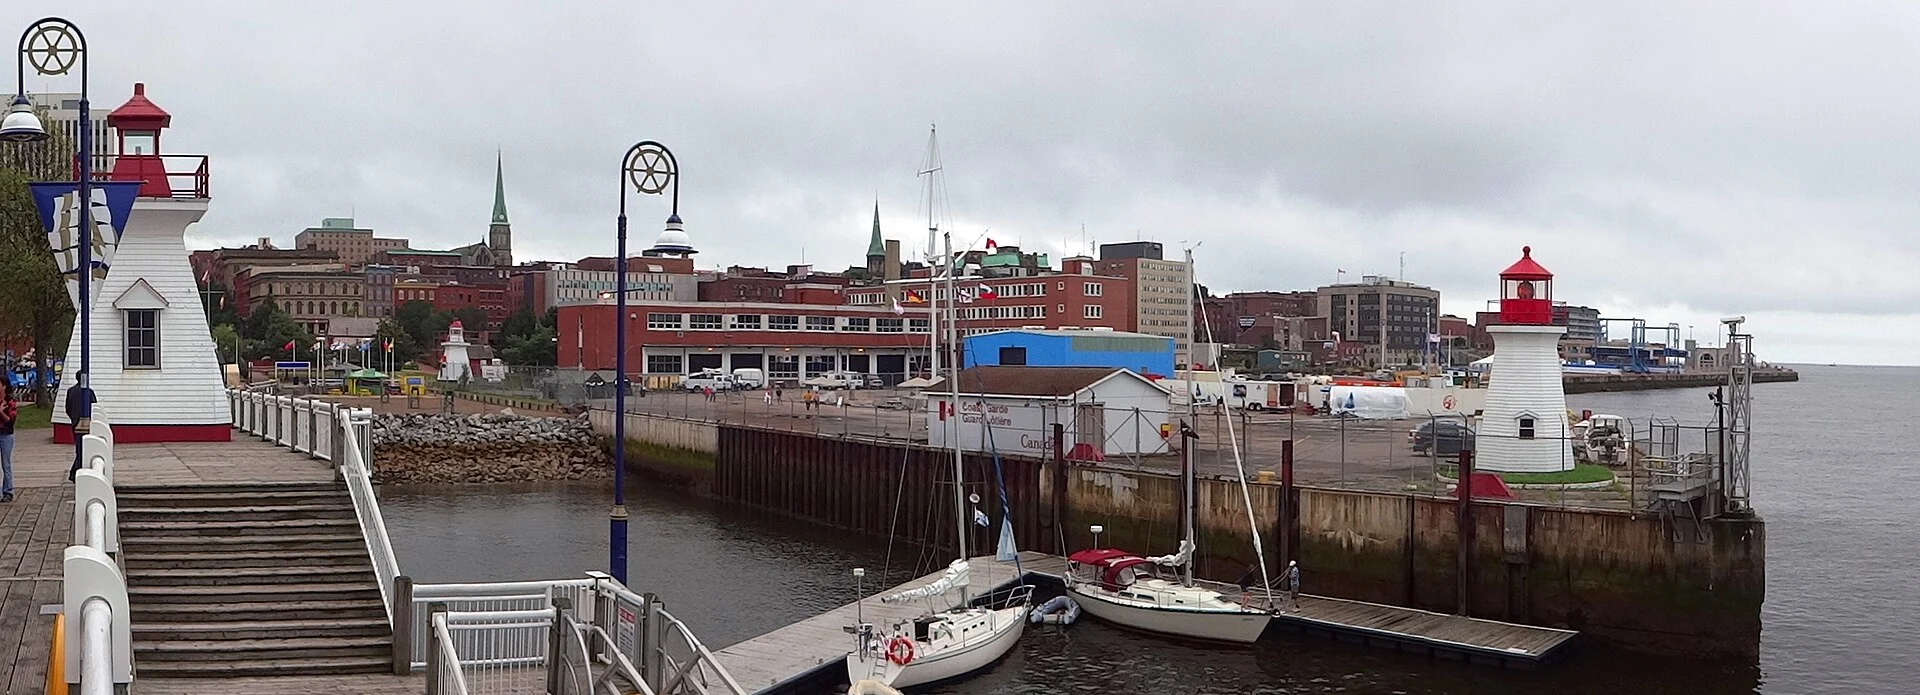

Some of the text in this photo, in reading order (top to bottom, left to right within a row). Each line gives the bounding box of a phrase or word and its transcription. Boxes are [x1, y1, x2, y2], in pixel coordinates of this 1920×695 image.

[963, 401, 1008, 413] Coast Garde
[963, 413, 984, 423] Guard
